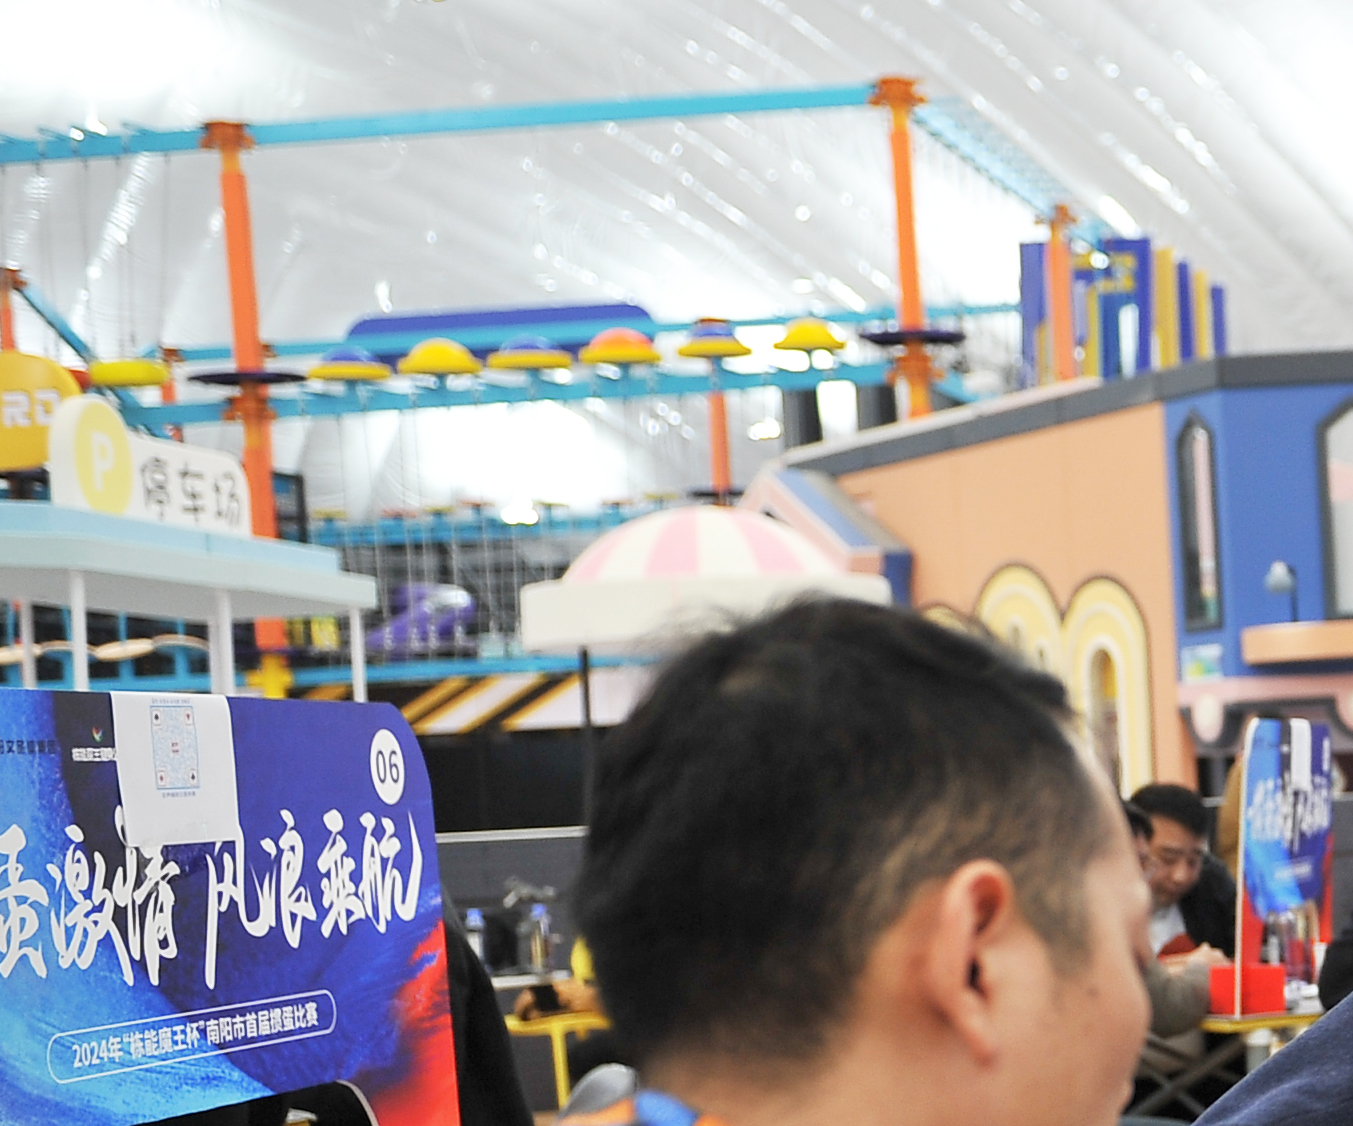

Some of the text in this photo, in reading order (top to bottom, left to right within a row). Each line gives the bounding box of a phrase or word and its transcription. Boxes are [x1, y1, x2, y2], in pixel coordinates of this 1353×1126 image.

[90, 432, 115, 492] P
[141, 455, 240, 524] 停车场
[375, 749, 400, 783] 06
